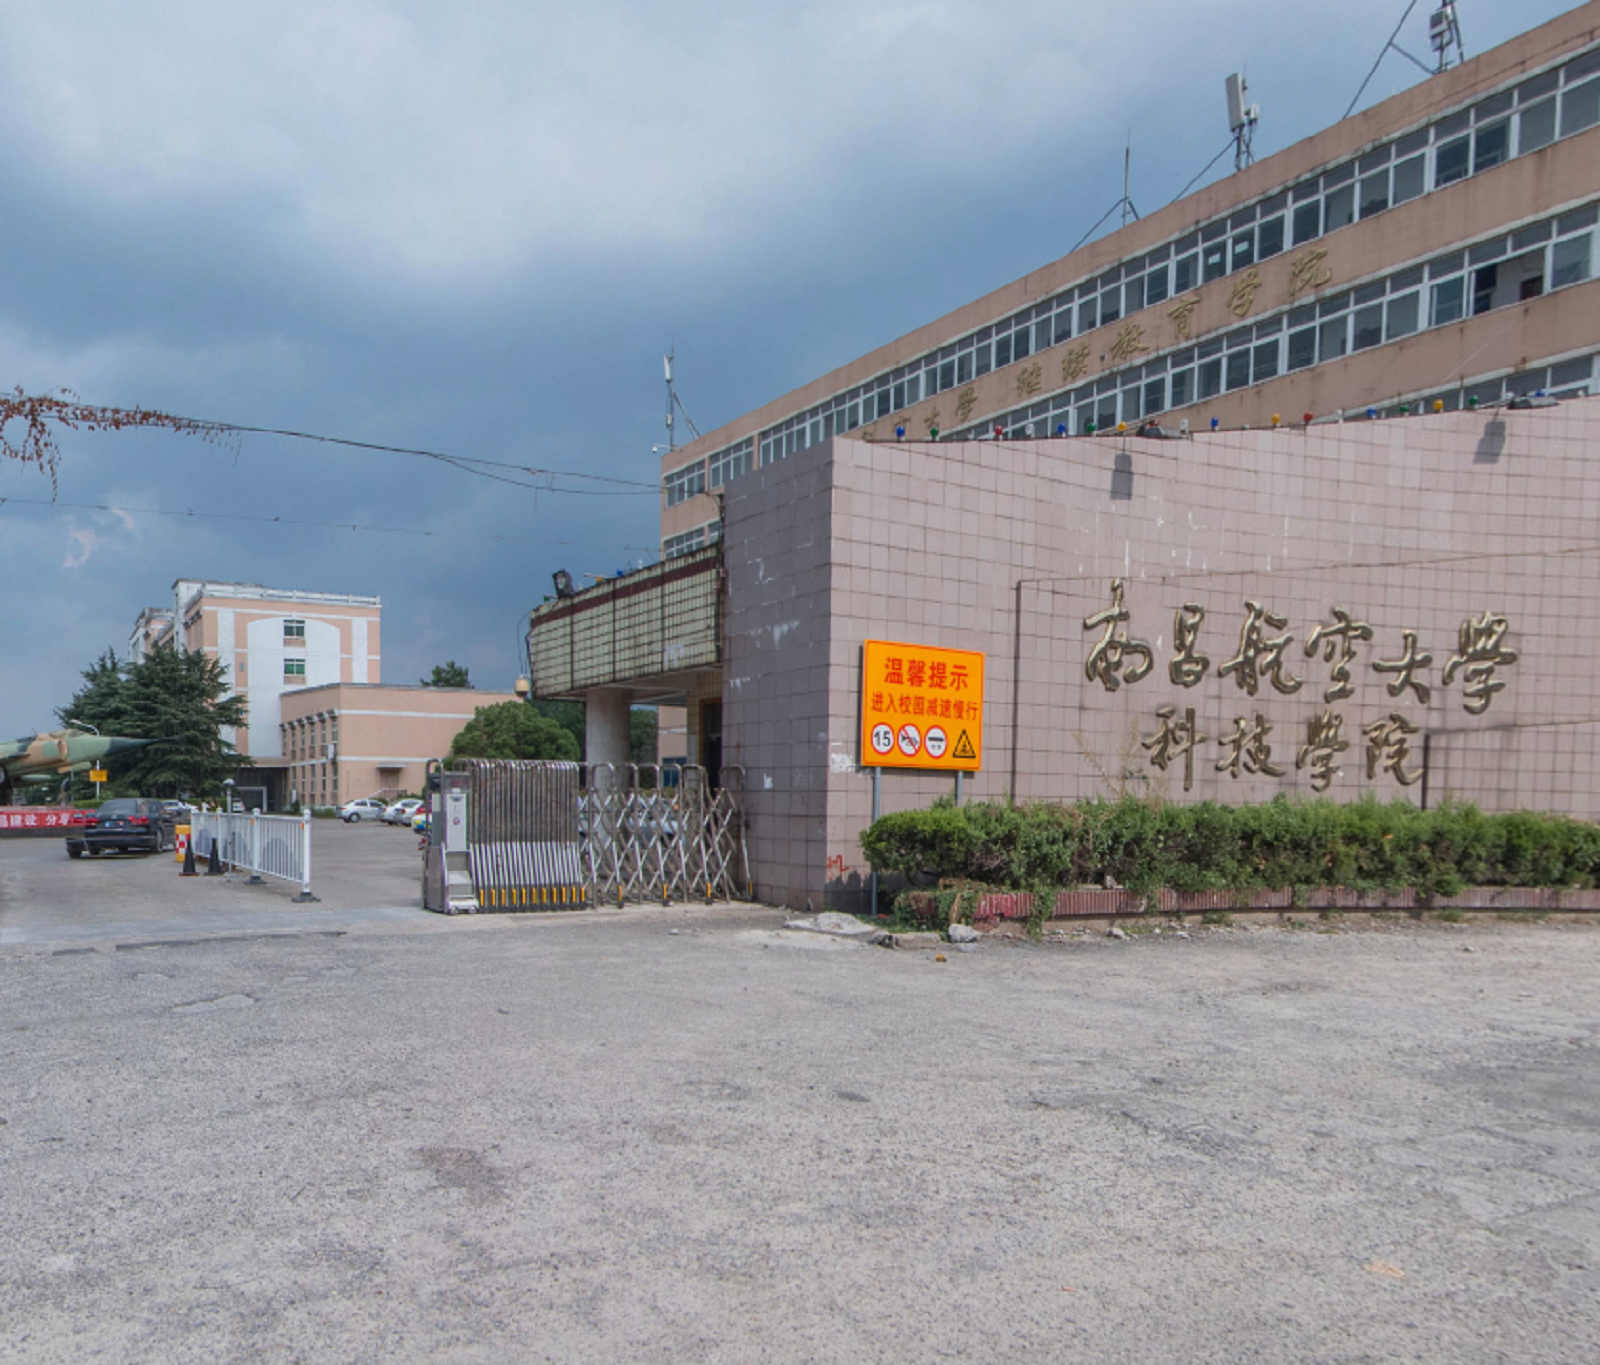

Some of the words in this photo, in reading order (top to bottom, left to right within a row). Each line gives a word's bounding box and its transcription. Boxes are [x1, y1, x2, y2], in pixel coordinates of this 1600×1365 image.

[884, 657, 969, 692] 温馨提示
[870, 691, 979, 721] 进入校园减速慢行
[874, 731, 891, 747] 15
